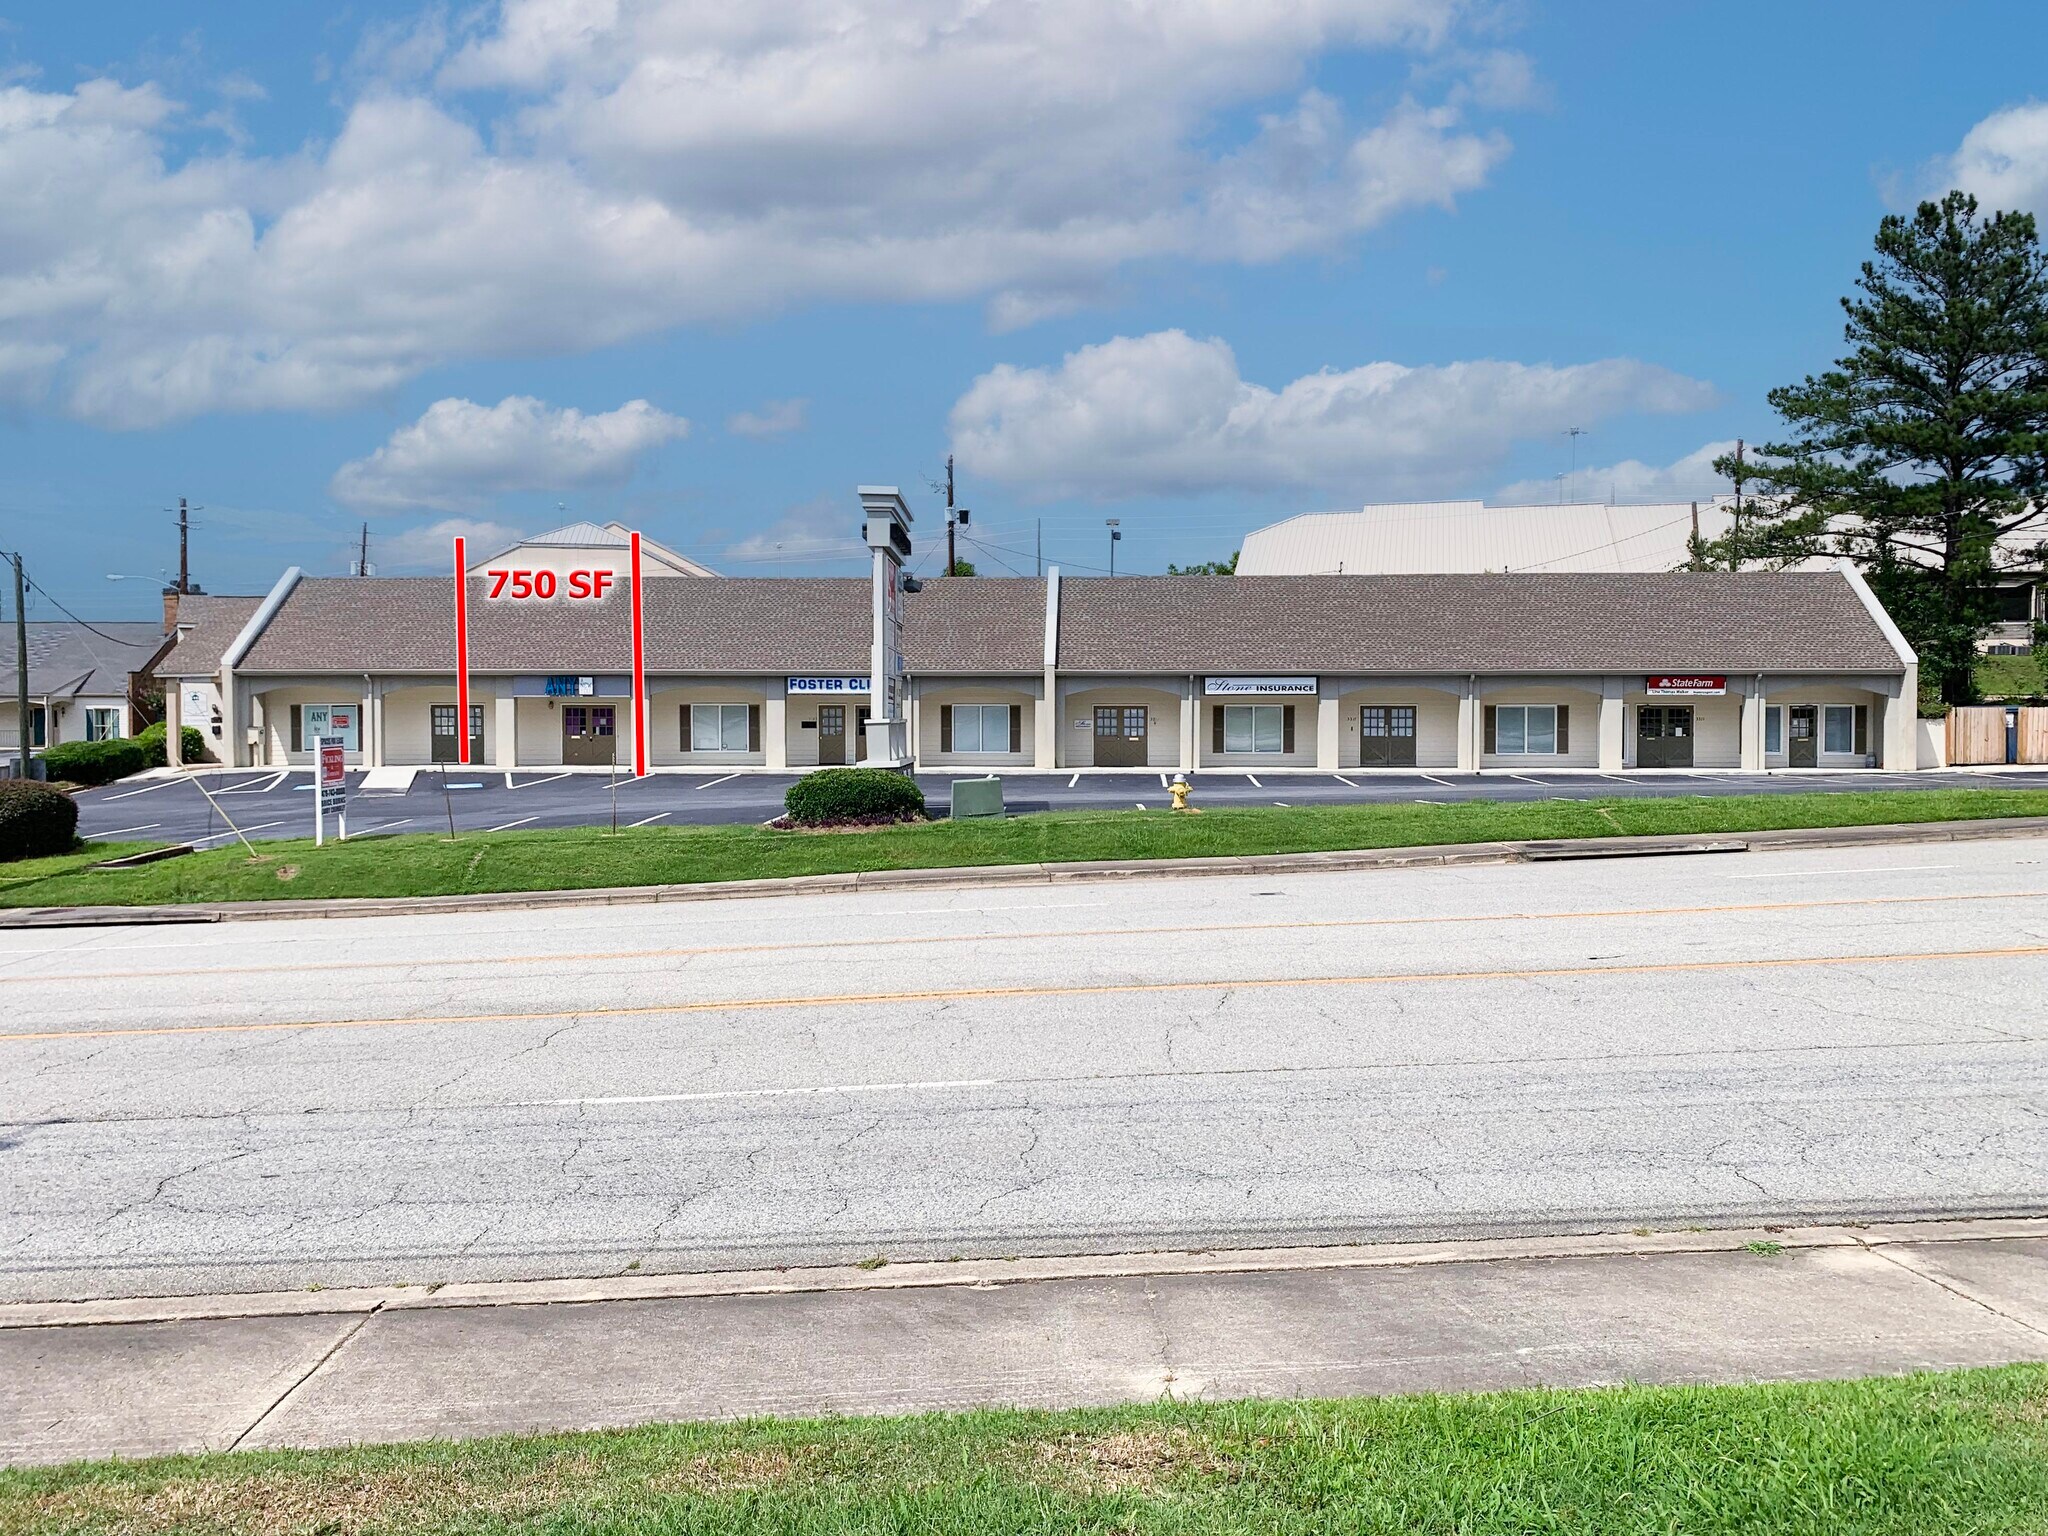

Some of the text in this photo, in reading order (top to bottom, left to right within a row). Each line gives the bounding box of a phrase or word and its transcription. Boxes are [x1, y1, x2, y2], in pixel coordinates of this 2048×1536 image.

[545, 677, 577, 696] ANY
[790, 679, 870, 690] FOSTER CLI
[1207, 679, 1252, 692] Stone
[311, 711, 328, 722] ANY
